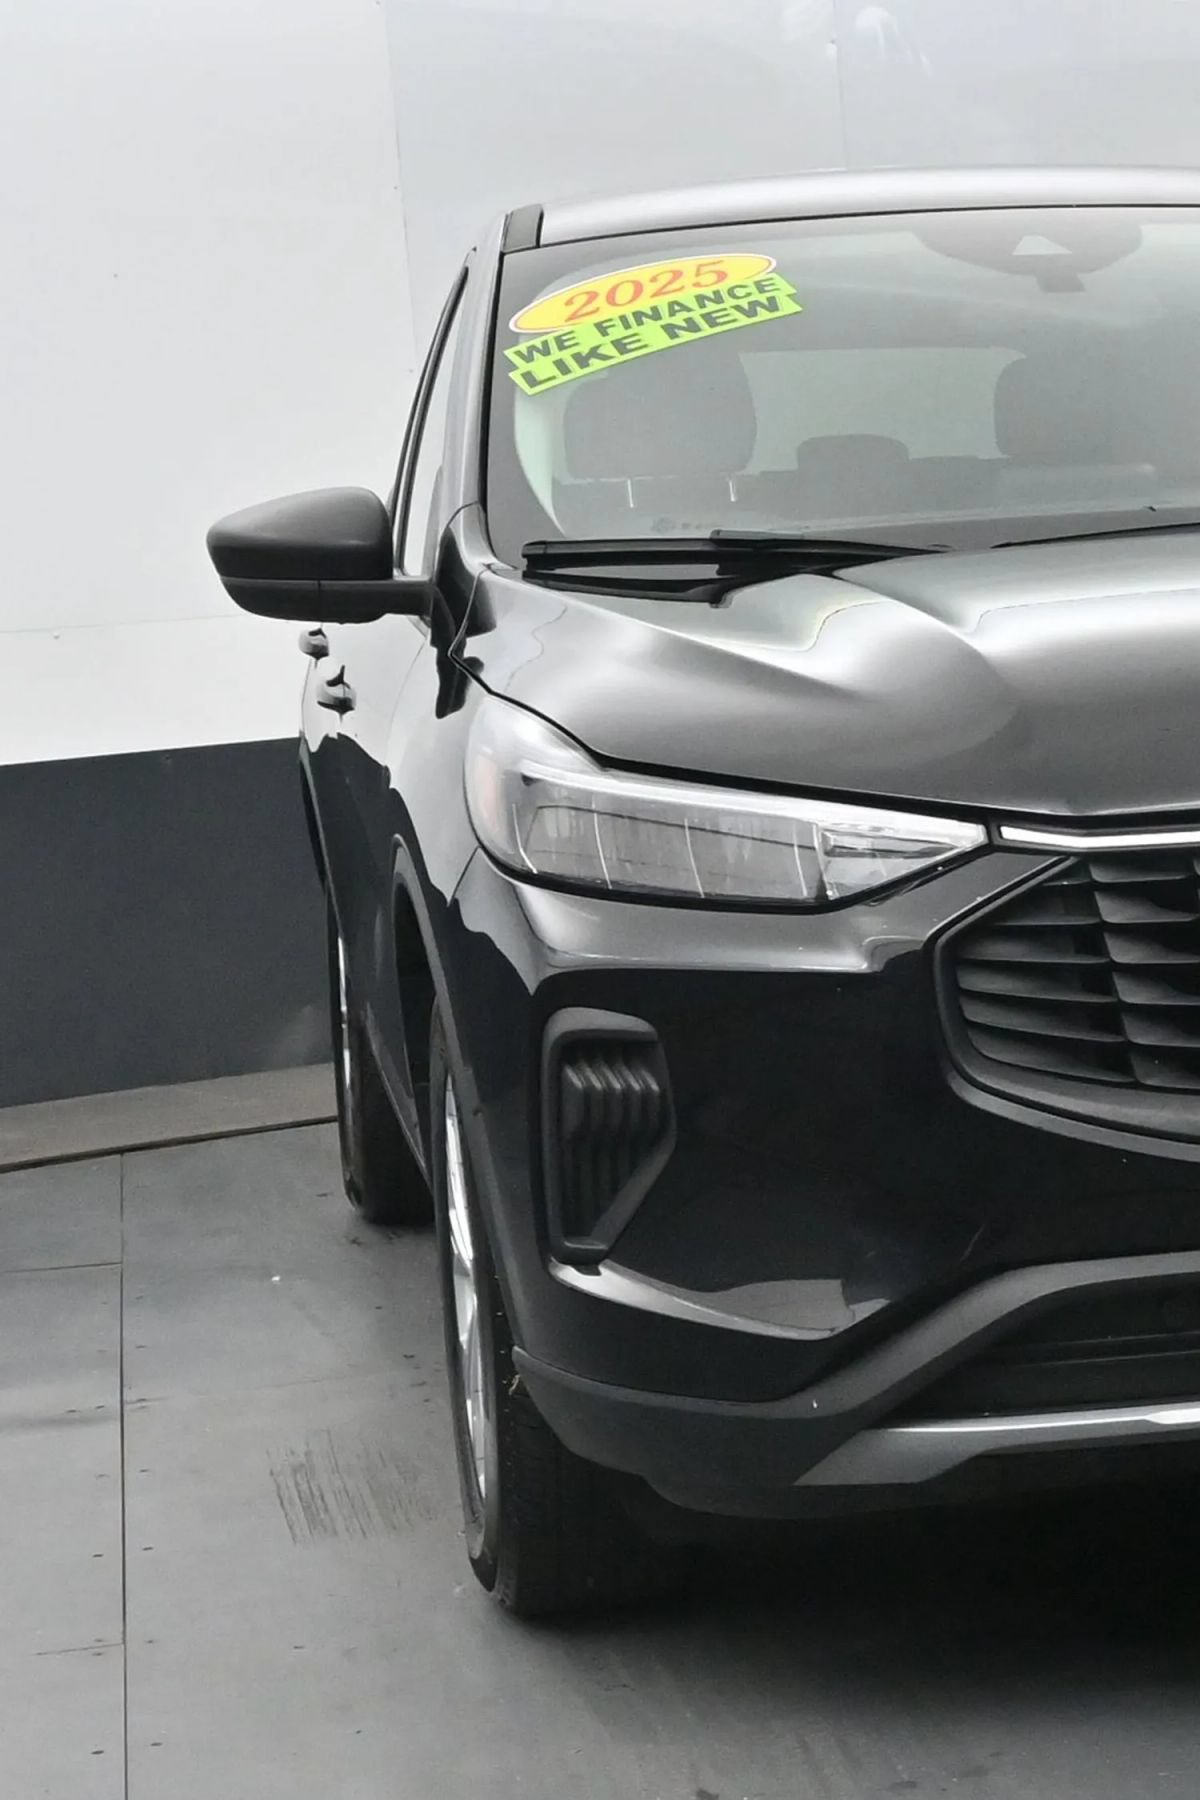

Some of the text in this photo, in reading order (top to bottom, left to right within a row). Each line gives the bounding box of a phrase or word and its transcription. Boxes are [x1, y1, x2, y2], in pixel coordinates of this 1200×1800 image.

[514, 277, 781, 364] WE FINANCE
[564, 260, 728, 322] 2025
[521, 295, 782, 388] LIKE NEW
